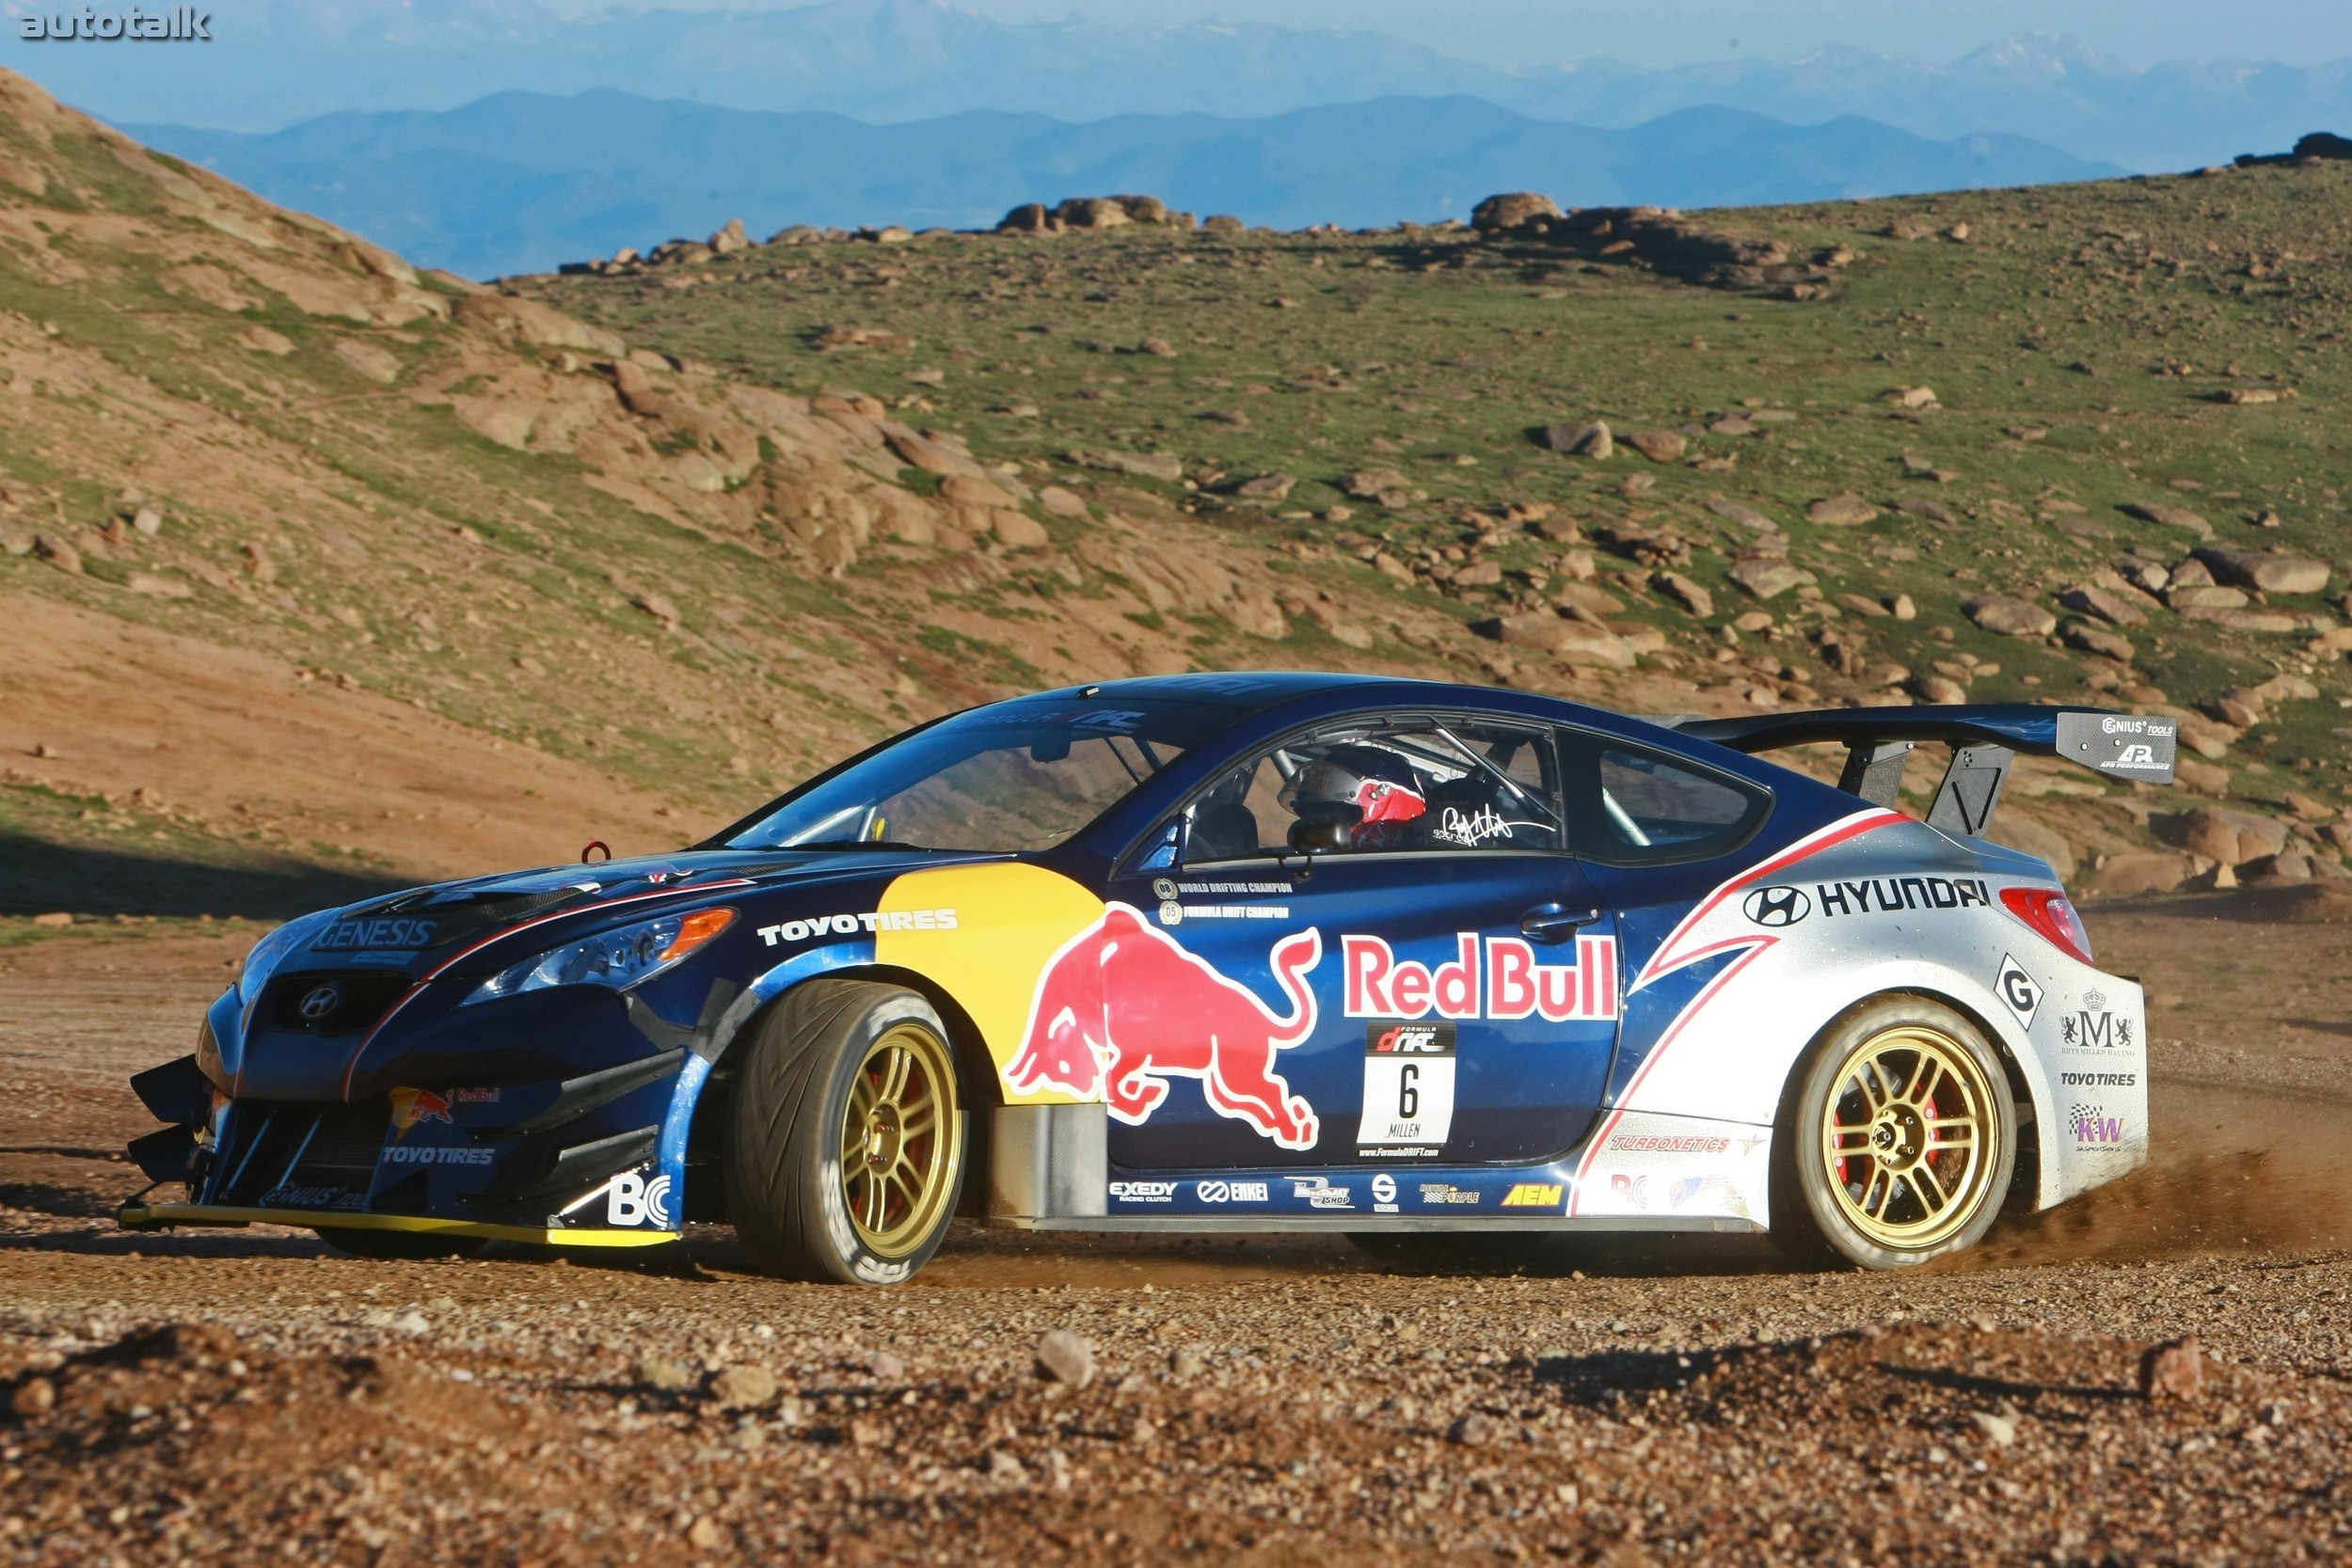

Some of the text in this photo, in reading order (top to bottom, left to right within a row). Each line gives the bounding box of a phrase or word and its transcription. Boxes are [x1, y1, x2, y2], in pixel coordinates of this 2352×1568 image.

[2147, 725, 2173, 736] TOOLS
[1159, 882, 1293, 894] 08 WORLD DRIFTING CHAMPION
[1817, 878, 1992, 917] HYUNDAI
[1166, 906, 1289, 919] 05 FORMULA DRIFT CHAMPION
[316, 918, 437, 948] GENESIS
[1342, 932, 1618, 1022] Red Bull
[2003, 970, 2035, 1012] G
[2076, 1010, 2117, 1048] M
[2106, 1049, 2136, 1057] RACING
[1399, 1064, 1419, 1119] 6
[1387, 1124, 1421, 1138] MILLEN
[2077, 1117, 2123, 1142] KW
[1359, 1147, 1439, 1157] www.FormulaDRIFT.com
[1611, 1135, 1731, 1152] TURBONETICS
[1109, 1181, 1178, 1196] EXEDY
[1231, 1182, 1268, 1202] ENKEI
[1441, 1192, 1480, 1203] PURPLE
[1501, 1183, 1563, 1207] AEM
